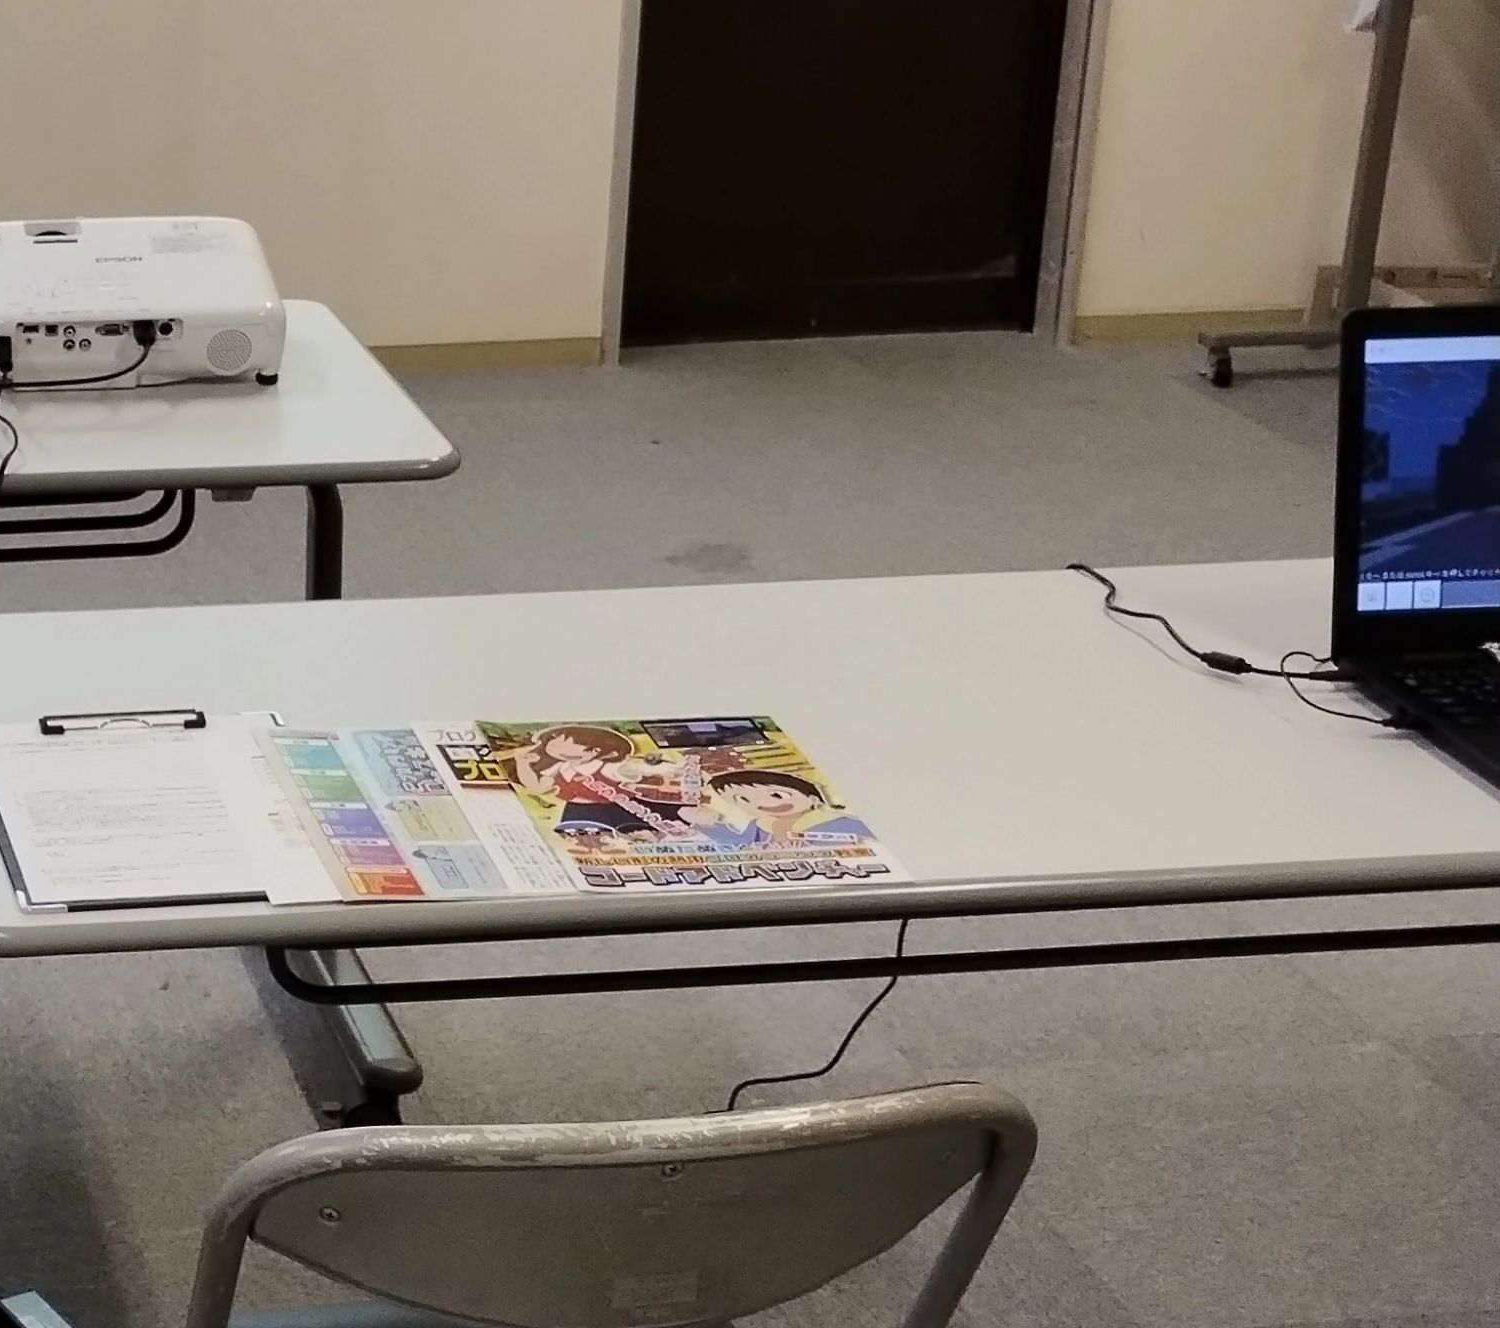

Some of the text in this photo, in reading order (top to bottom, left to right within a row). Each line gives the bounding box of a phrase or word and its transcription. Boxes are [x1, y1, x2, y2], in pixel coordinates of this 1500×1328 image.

[95, 256, 143, 264] EPSON
[579, 858, 891, 888] コードアドベンチャー
